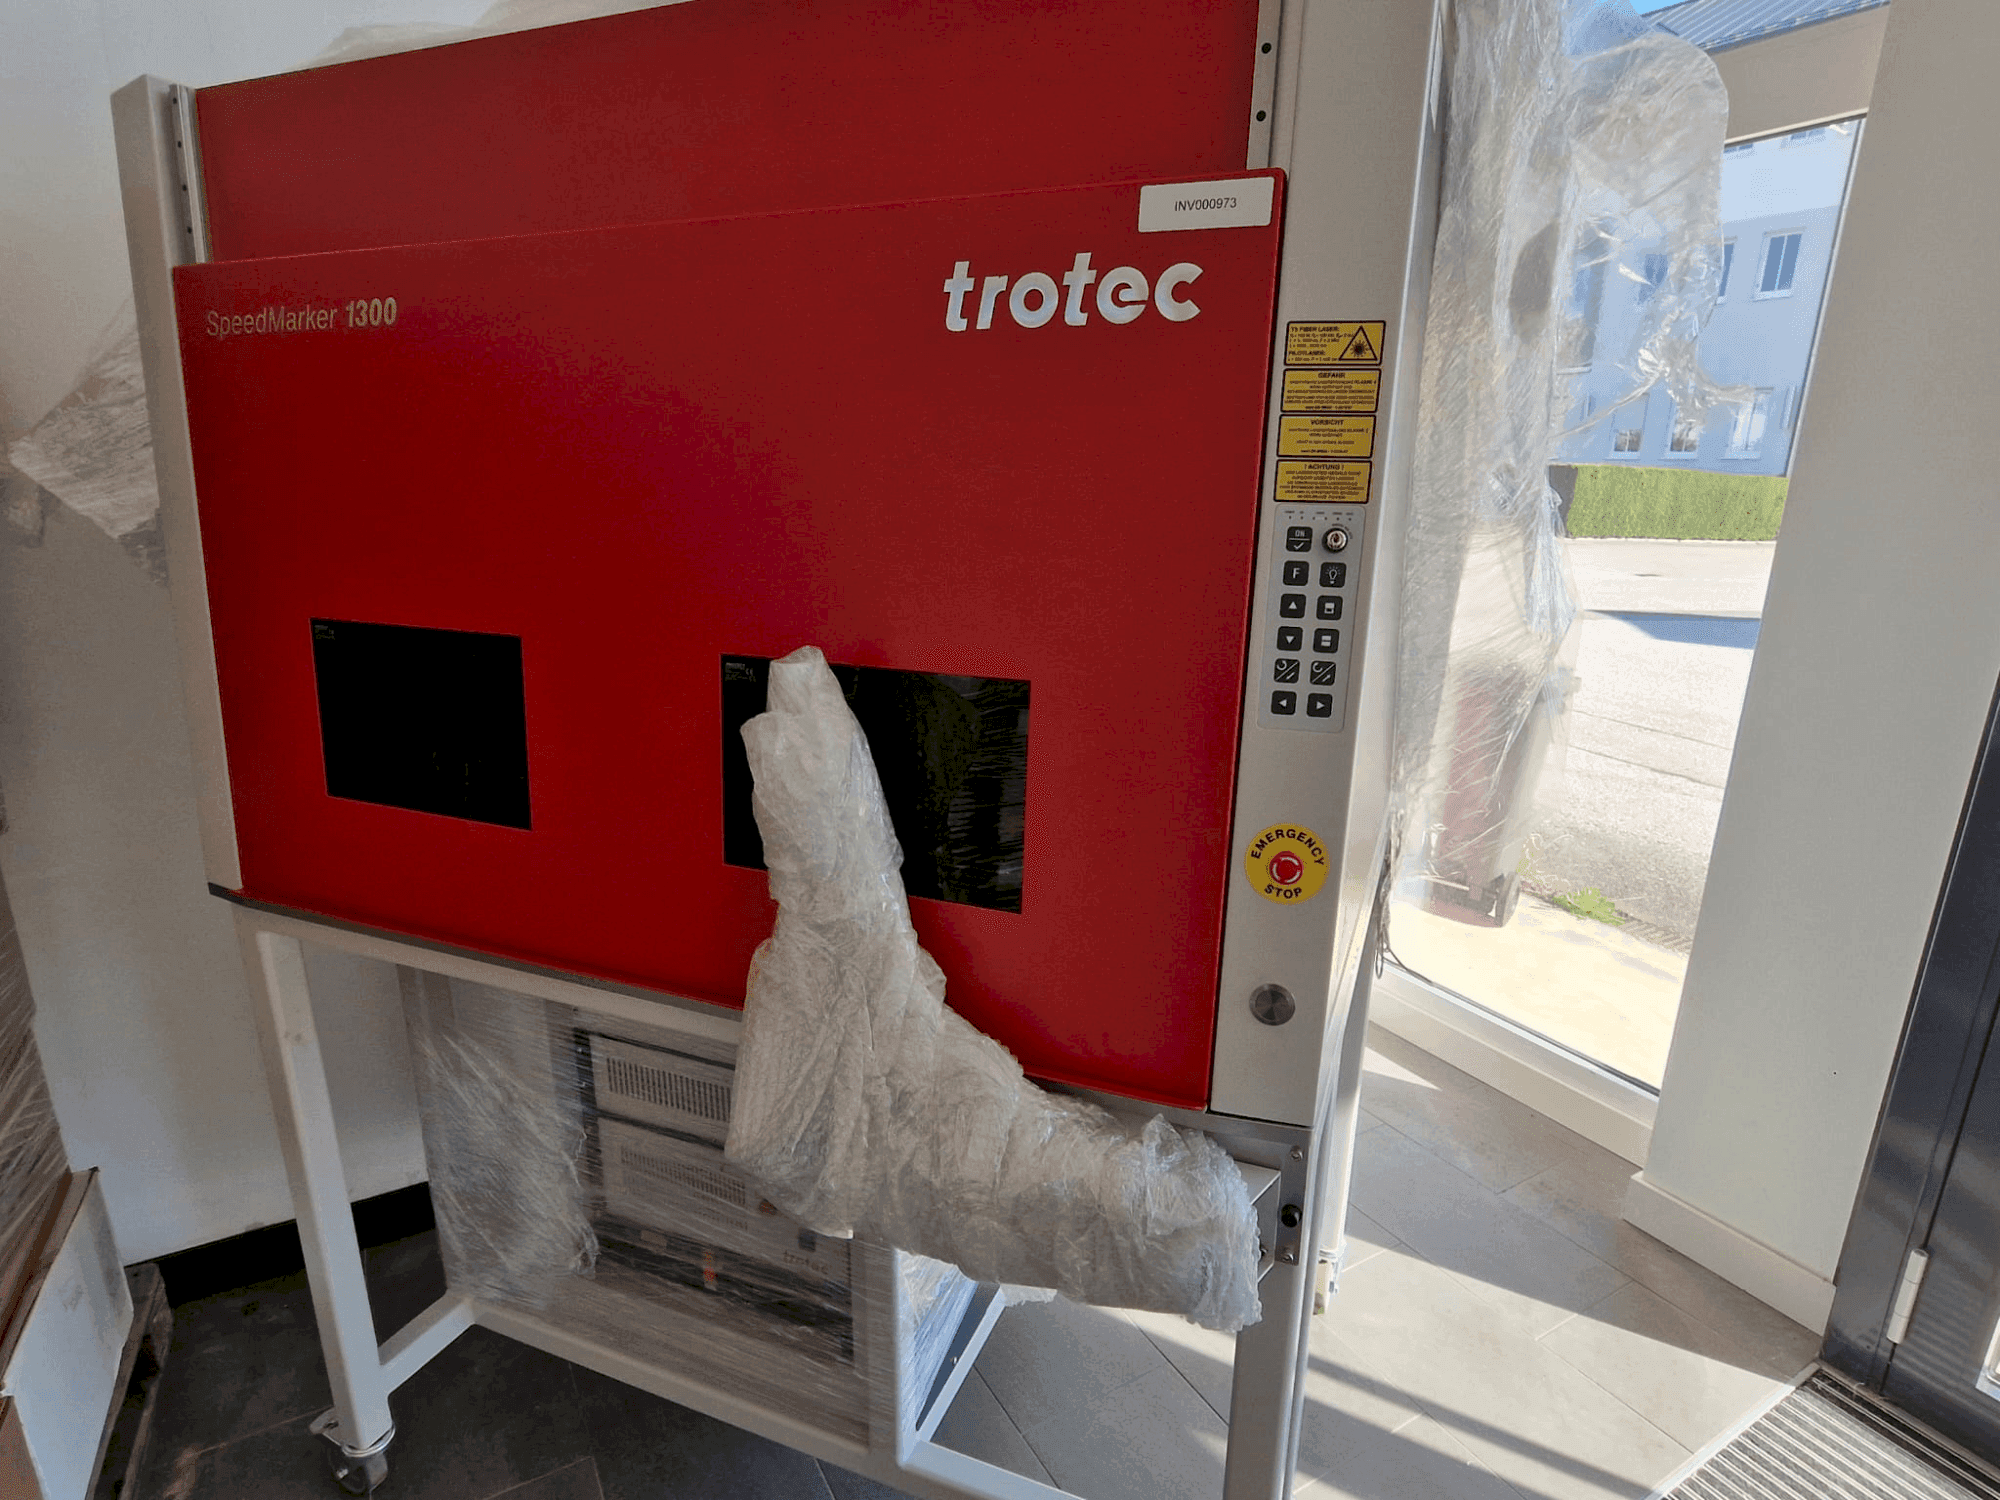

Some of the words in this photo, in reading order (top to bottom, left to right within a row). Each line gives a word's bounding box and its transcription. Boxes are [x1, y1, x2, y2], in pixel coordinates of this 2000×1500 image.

[1174, 197, 1238, 212] INV000973
[943, 252, 1204, 332] trotec
[206, 303, 338, 341] SpeedMarker
[345, 296, 398, 328] 1300
[1292, 567, 1301, 579] F
[1250, 828, 1325, 866] EMERGENCY
[1264, 884, 1303, 899] STOP
